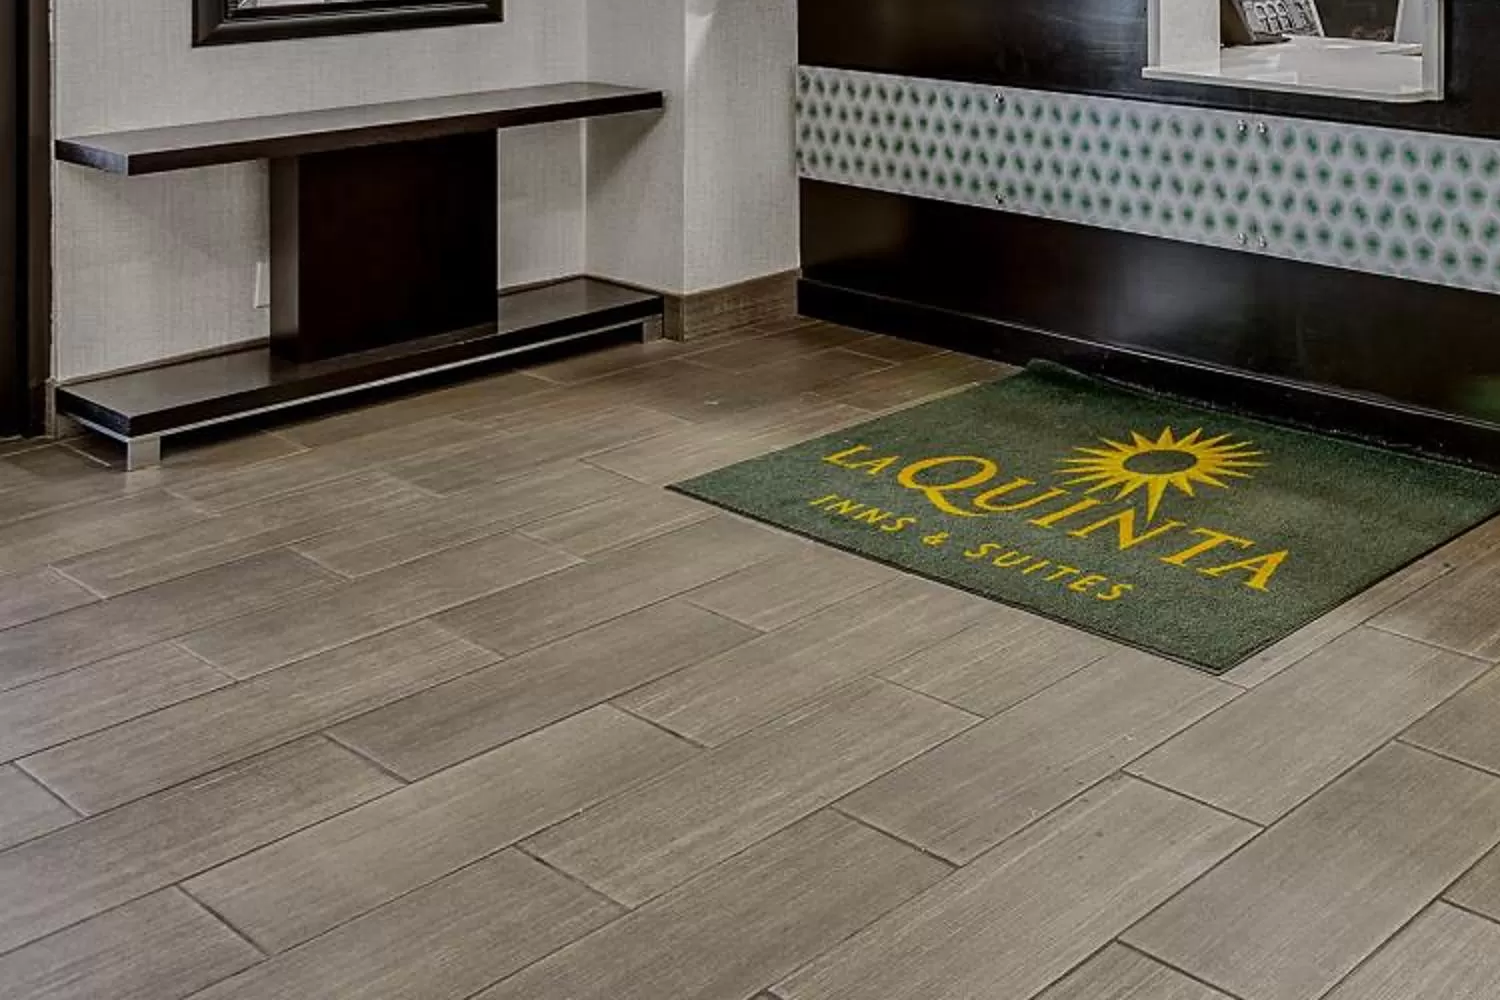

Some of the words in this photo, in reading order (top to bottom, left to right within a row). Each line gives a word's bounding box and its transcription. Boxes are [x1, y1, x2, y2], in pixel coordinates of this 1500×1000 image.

[808, 493, 918, 533] INNS
[921, 531, 951, 548] &
[963, 542, 1134, 601] SUITES
[821, 443, 899, 476] LA
[897, 455, 1290, 593] QUINTA
